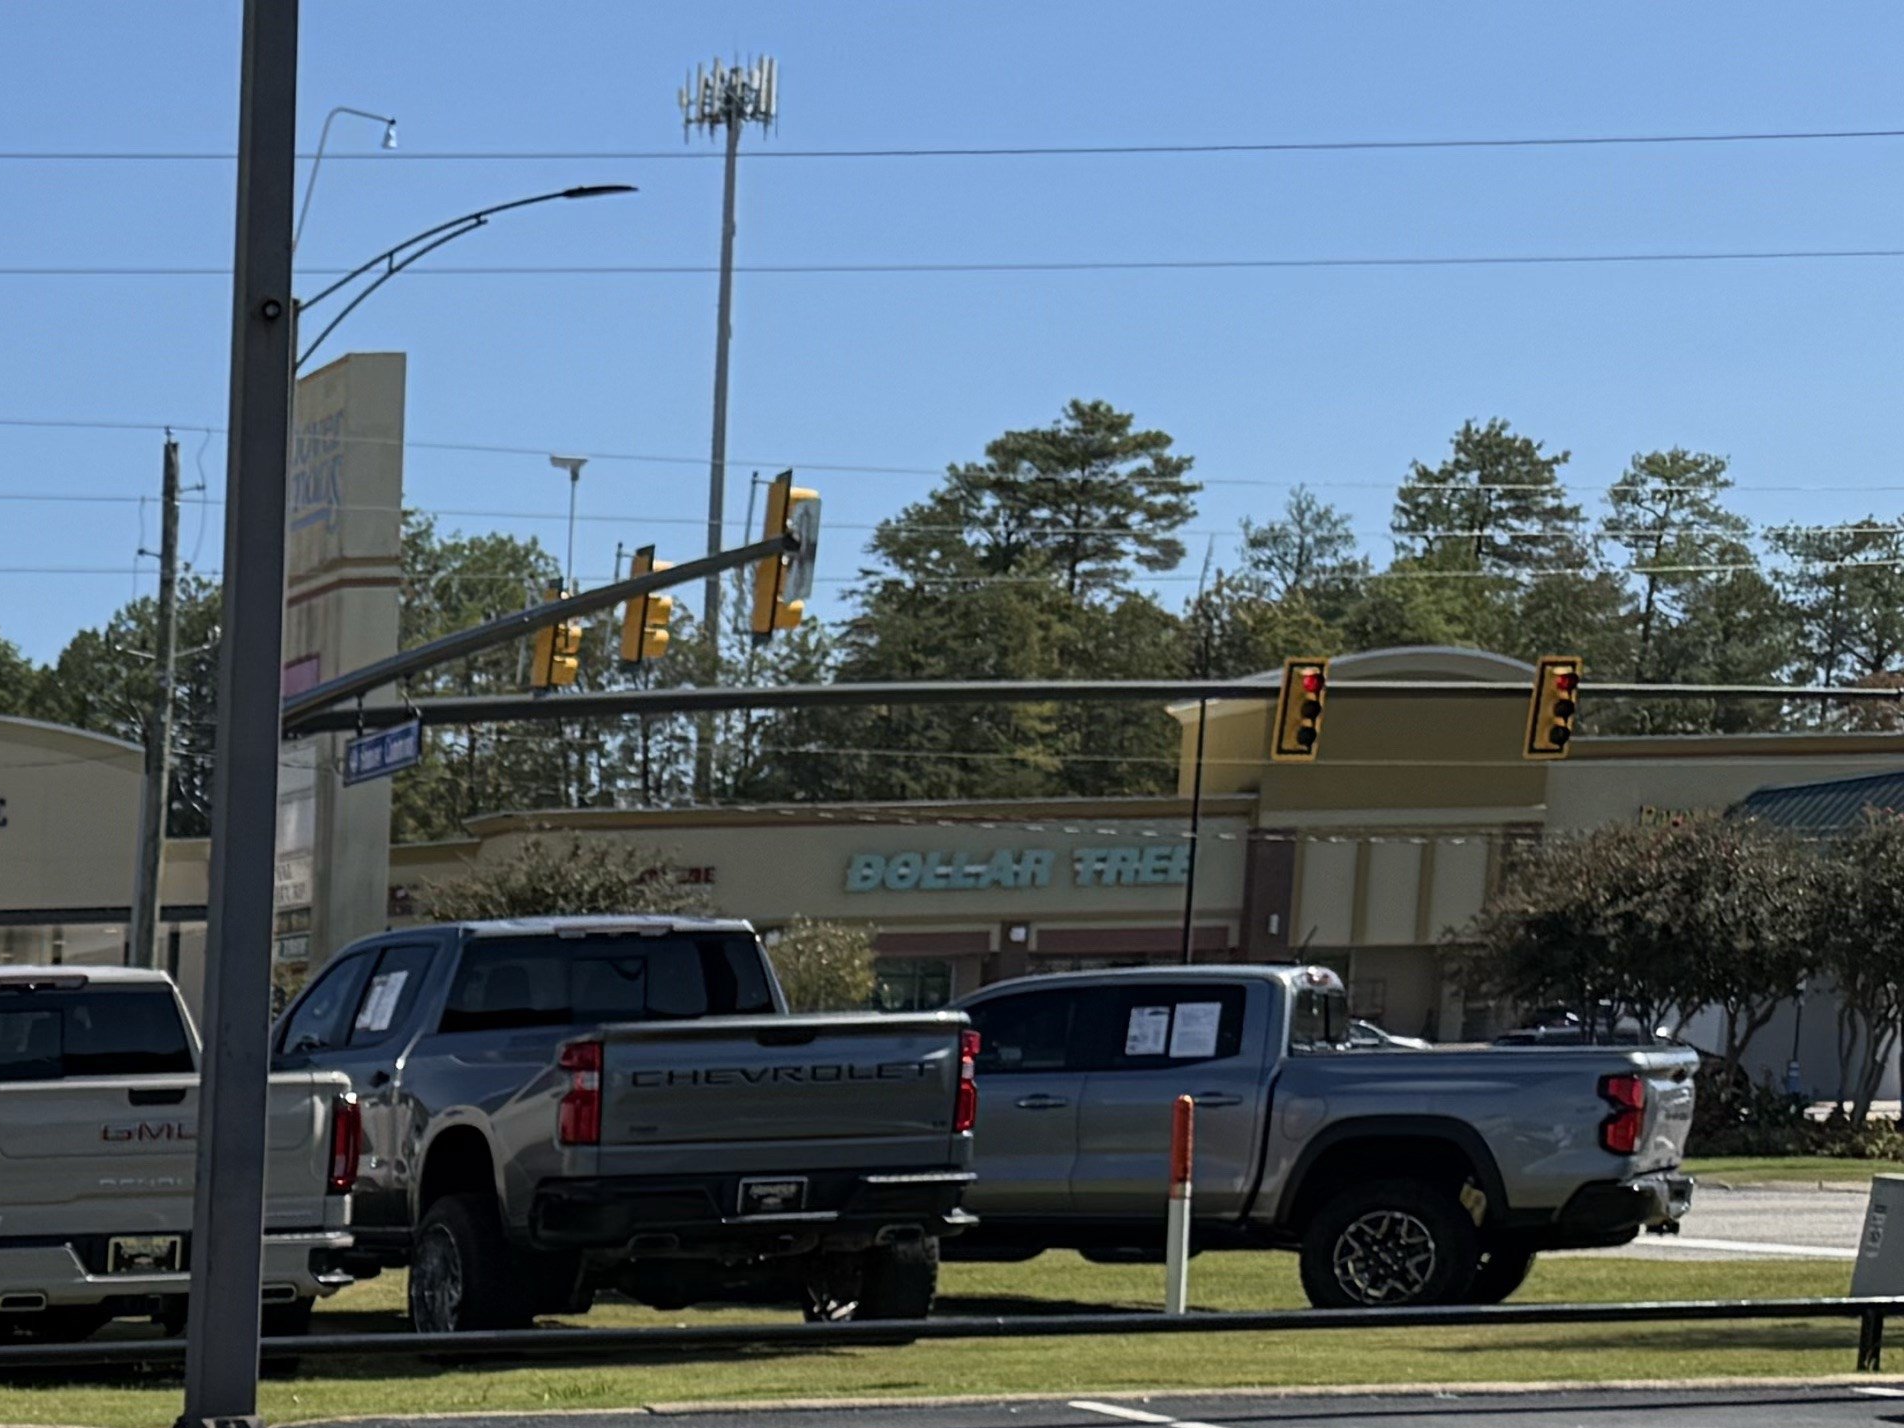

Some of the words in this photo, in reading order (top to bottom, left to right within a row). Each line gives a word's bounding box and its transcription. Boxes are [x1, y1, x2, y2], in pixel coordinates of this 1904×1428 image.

[844, 850, 1055, 893] DOLLAR
[1072, 845, 1194, 887] TREE
[632, 1060, 934, 1088] CHEVROLET
